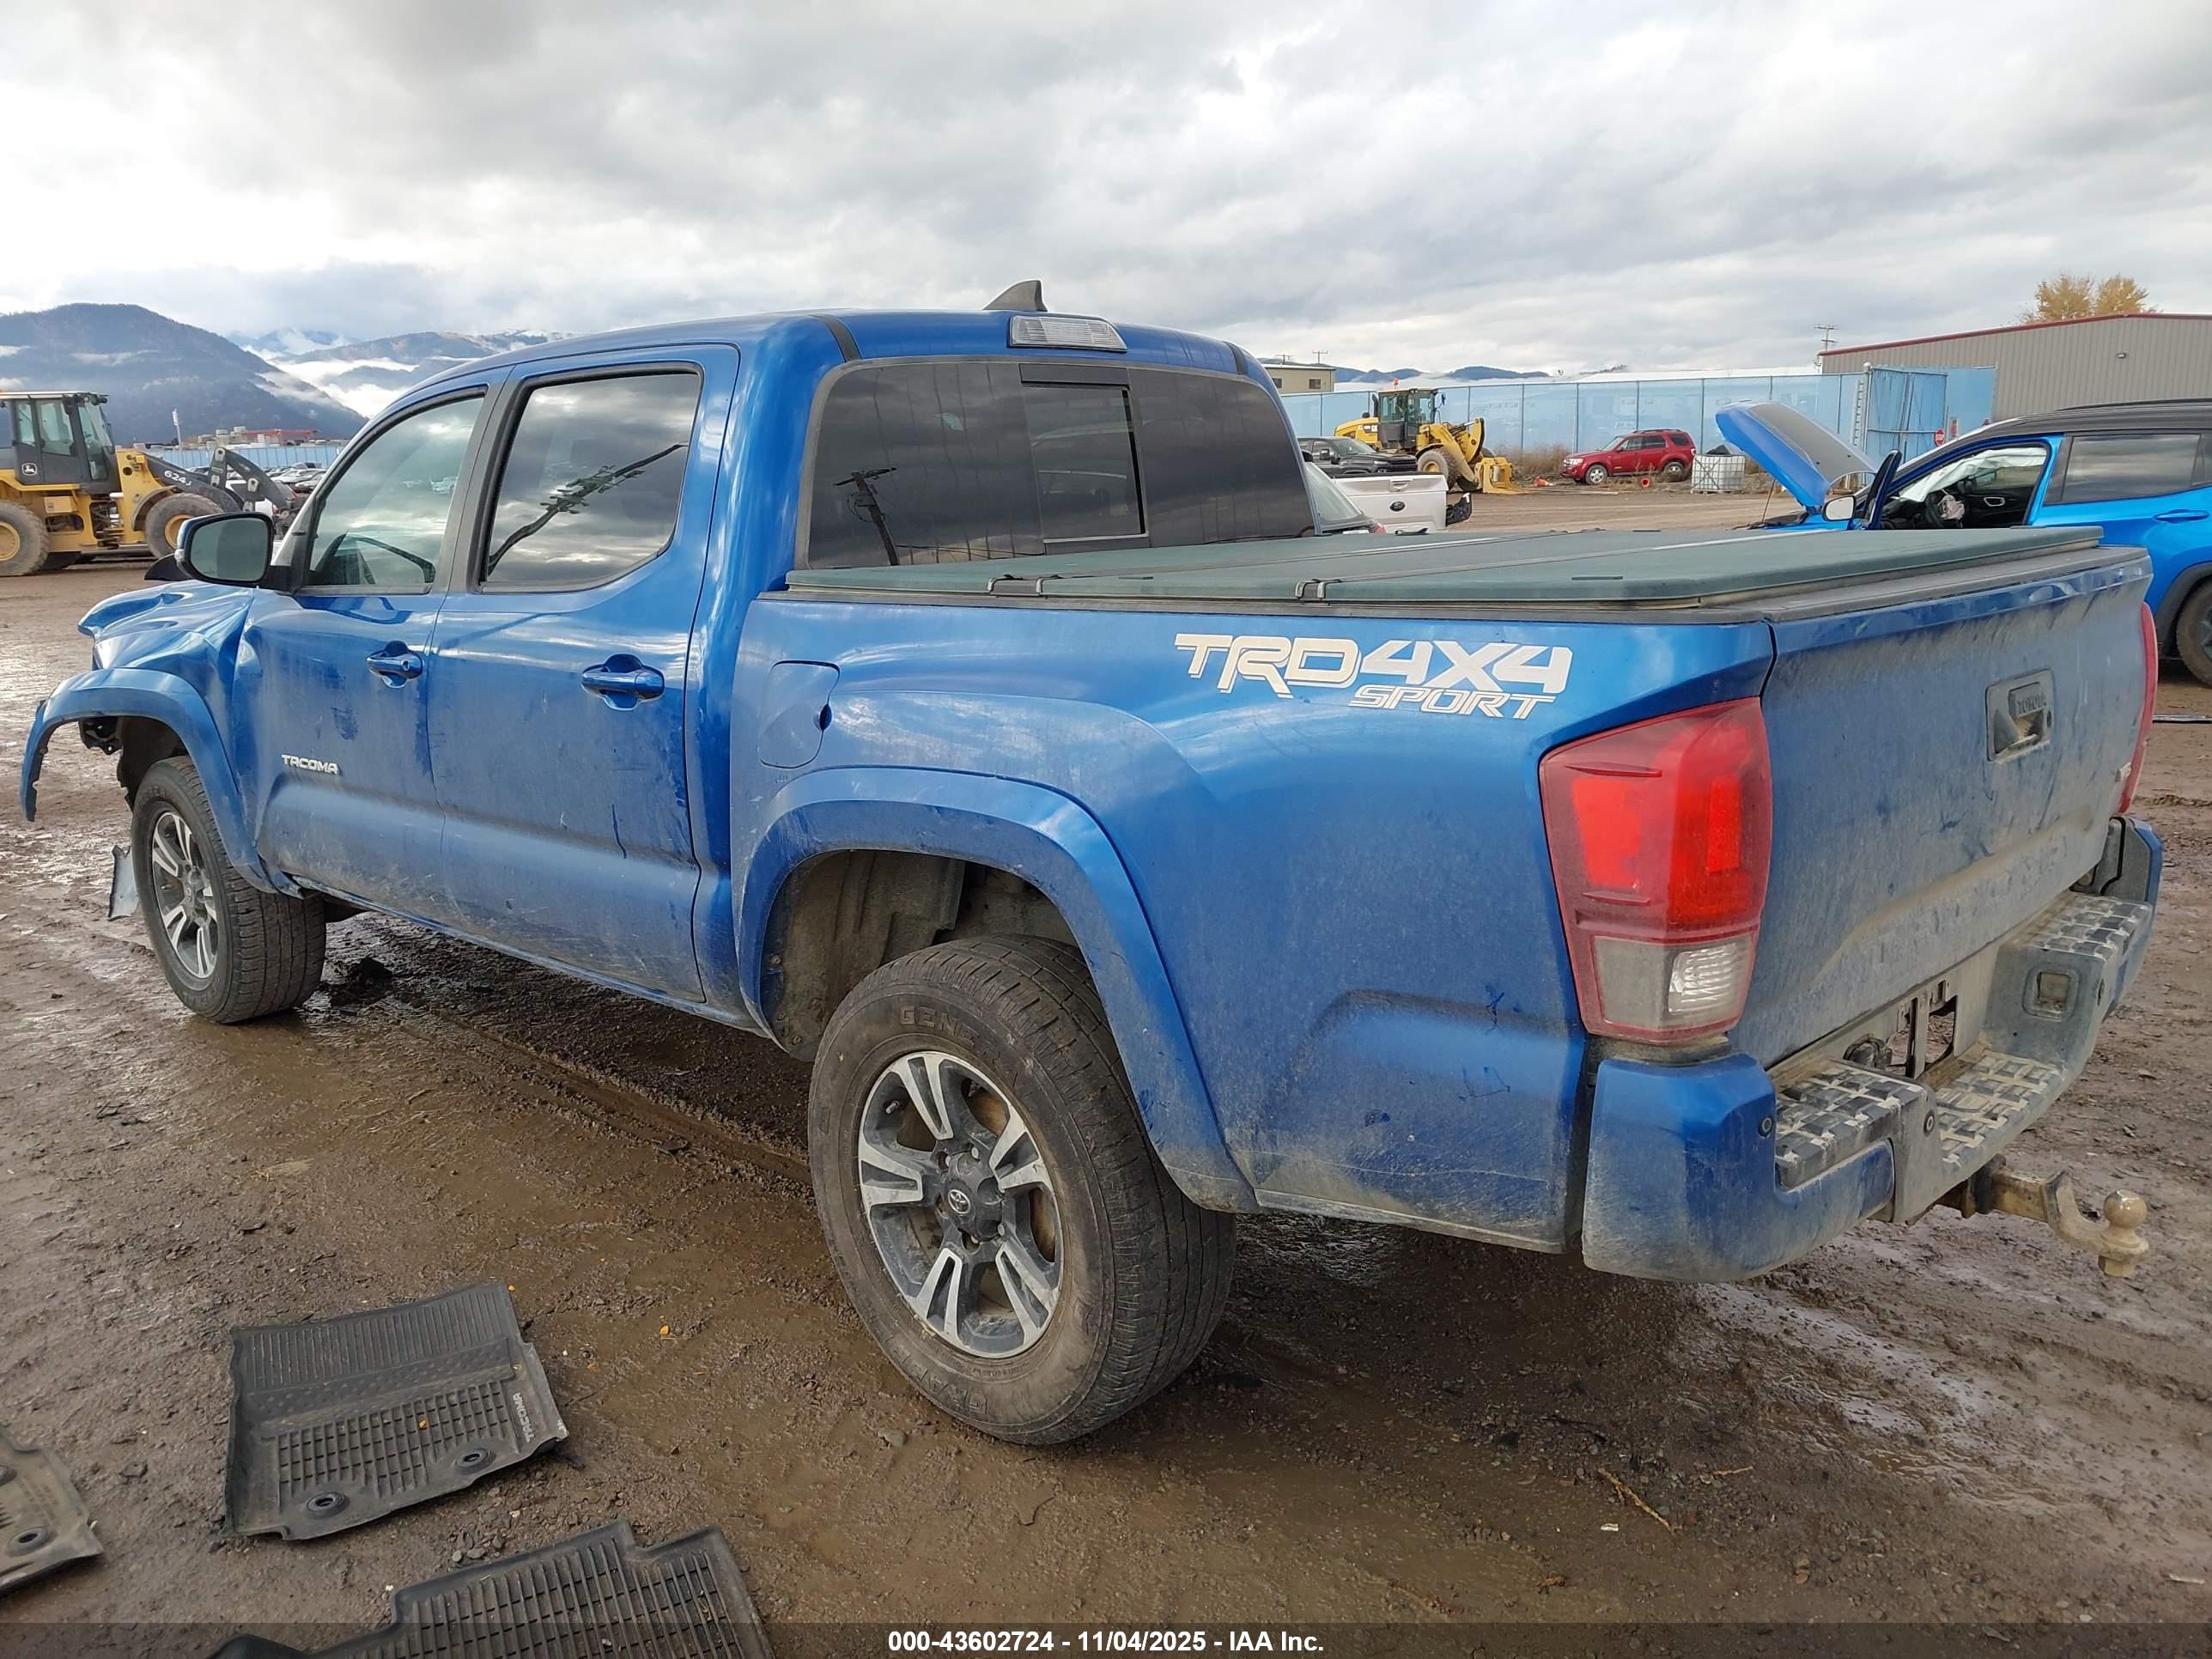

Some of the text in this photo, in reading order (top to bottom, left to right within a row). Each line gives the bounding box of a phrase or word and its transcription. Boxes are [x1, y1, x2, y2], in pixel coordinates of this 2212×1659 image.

[1348, 684, 1556, 720] SPORT
[281, 754, 338, 775] TACOMA
[513, 1392, 535, 1443] TACOMA
